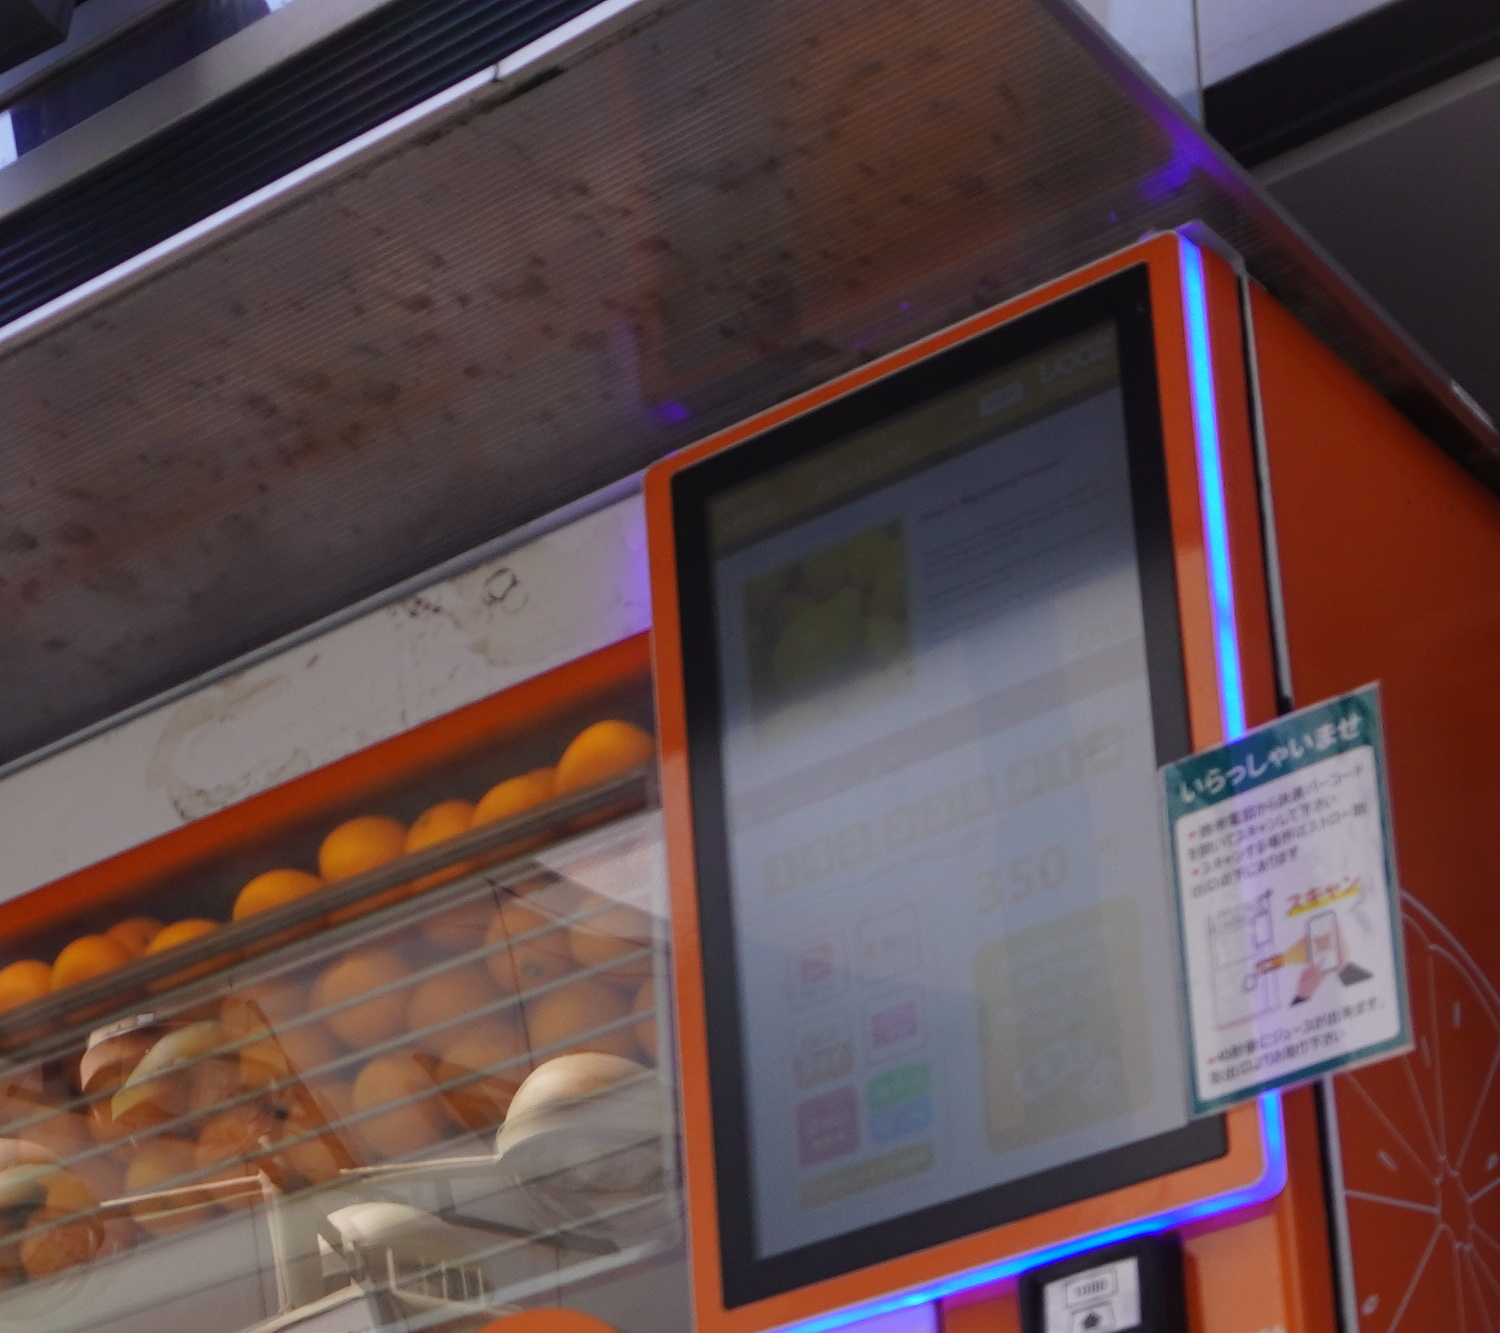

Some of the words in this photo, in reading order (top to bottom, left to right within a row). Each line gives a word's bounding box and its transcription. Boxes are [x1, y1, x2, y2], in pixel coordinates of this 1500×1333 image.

[1179, 712, 1364, 804] いらっしゃいませ
